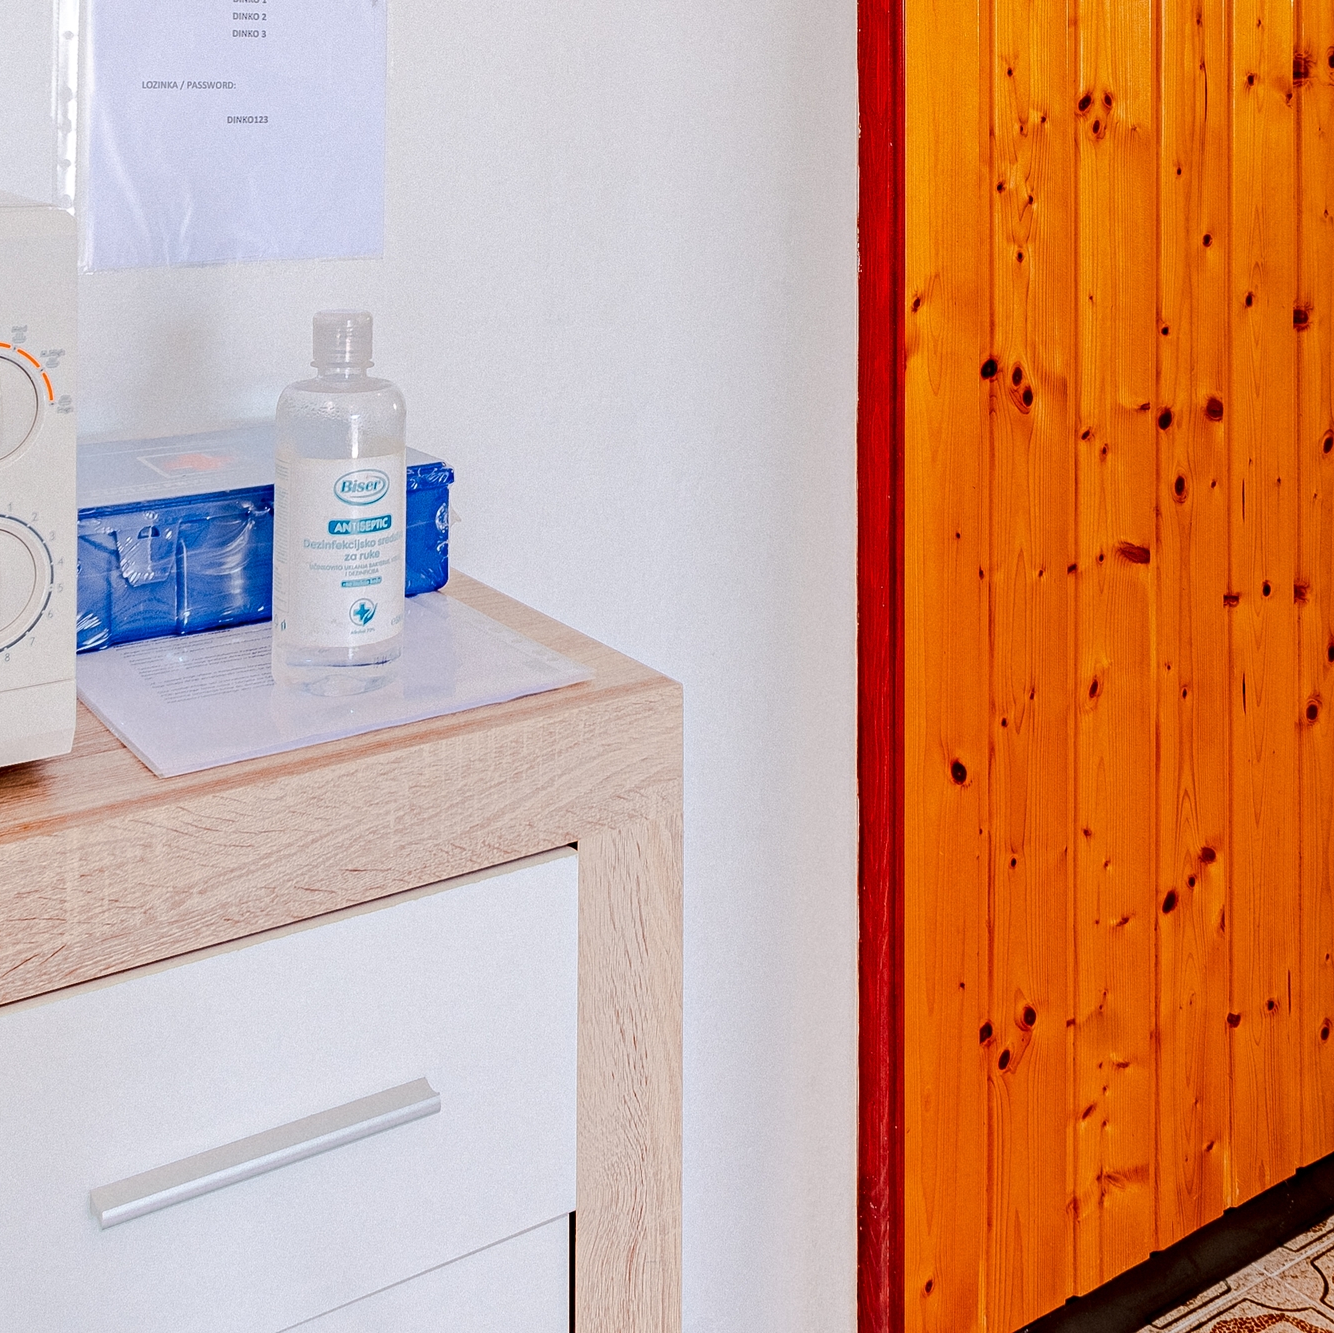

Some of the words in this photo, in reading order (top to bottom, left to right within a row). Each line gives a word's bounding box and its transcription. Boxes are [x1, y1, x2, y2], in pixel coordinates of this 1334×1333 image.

[232, 11, 260, 22] DINKO
[261, 12, 268, 22] 2
[232, 28, 260, 39] DINKO
[261, 29, 268, 39] 3
[141, 80, 179, 91] LOZINKA
[186, 80, 238, 91] PASSWORD:
[226, 114, 270, 125] DINKO123
[340, 479, 381, 494] Biser
[7, 502, 13, 512] 1
[31, 512, 39, 522] 2
[333, 517, 389, 533] ANTISEPTIC
[49, 531, 56, 542] 3
[303, 538, 377, 551] Dezinfekcijsko
[344, 553, 358, 562] za
[359, 550, 380, 561] ruke
[57, 557, 64, 567] 4
[57, 583, 64, 593] 5
[47, 609, 54, 619] 6
[28, 636, 36, 647] 7
[4, 652, 11, 663] 8
